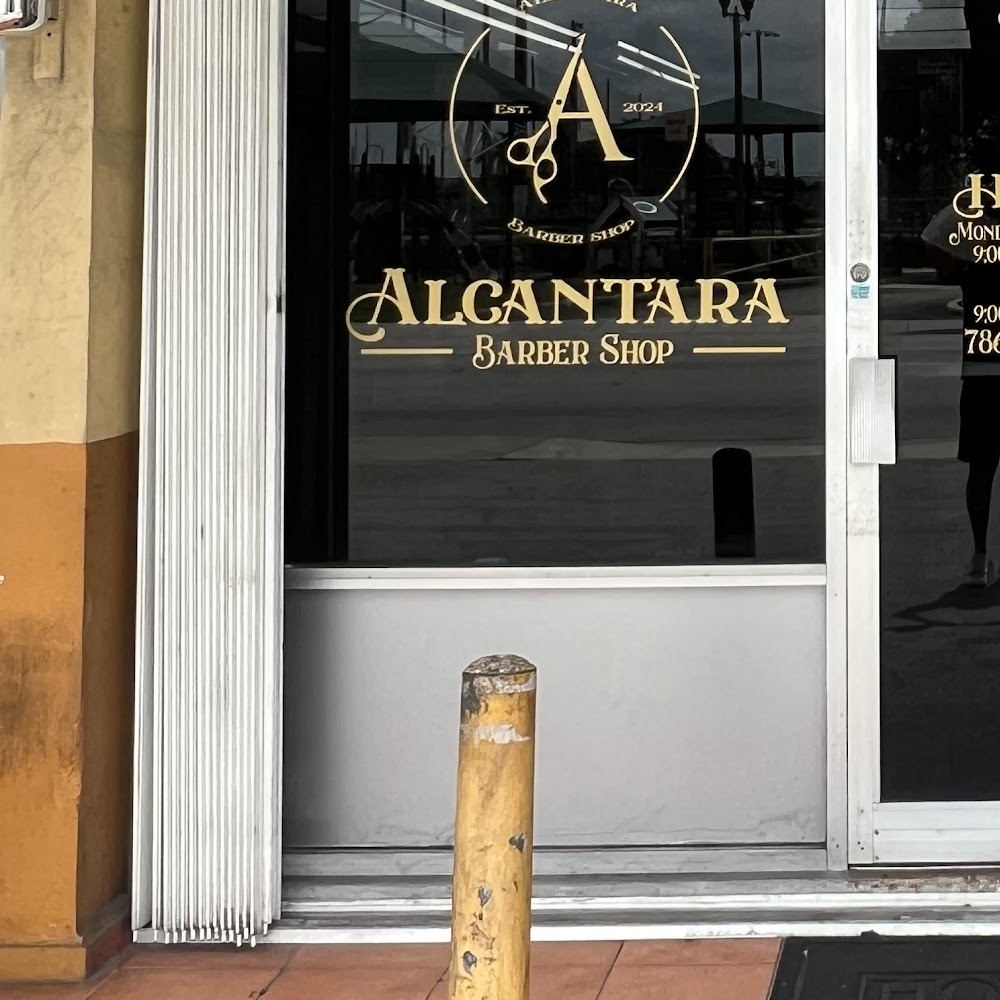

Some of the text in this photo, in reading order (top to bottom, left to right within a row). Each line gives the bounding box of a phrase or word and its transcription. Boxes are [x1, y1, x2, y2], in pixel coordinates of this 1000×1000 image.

[622, 102, 663, 113] 2024
[507, 217, 636, 245] BARBER SHOP
[346, 267, 790, 343] ALCANTARA
[472, 333, 675, 370] BARBER SHOP
